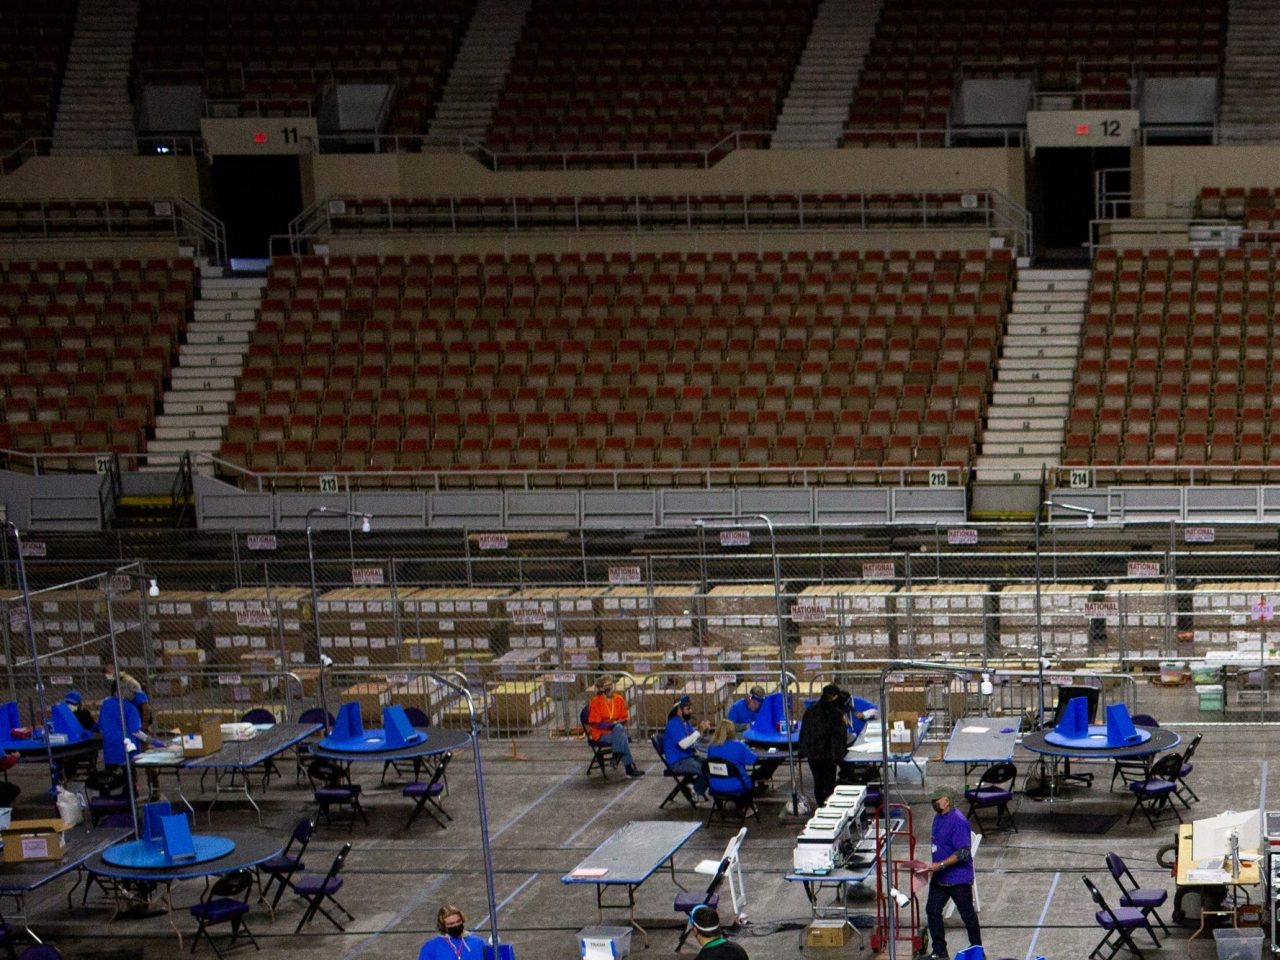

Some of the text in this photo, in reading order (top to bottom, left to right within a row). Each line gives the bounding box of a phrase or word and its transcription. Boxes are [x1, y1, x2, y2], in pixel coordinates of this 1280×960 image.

[1100, 120, 1121, 137] 12
[281, 127, 298, 144] 11
[321, 478, 337, 491] 213
[931, 473, 946, 486] 213
[1072, 472, 1087, 485] 214
[237, 609, 269, 617] NATIONAL
